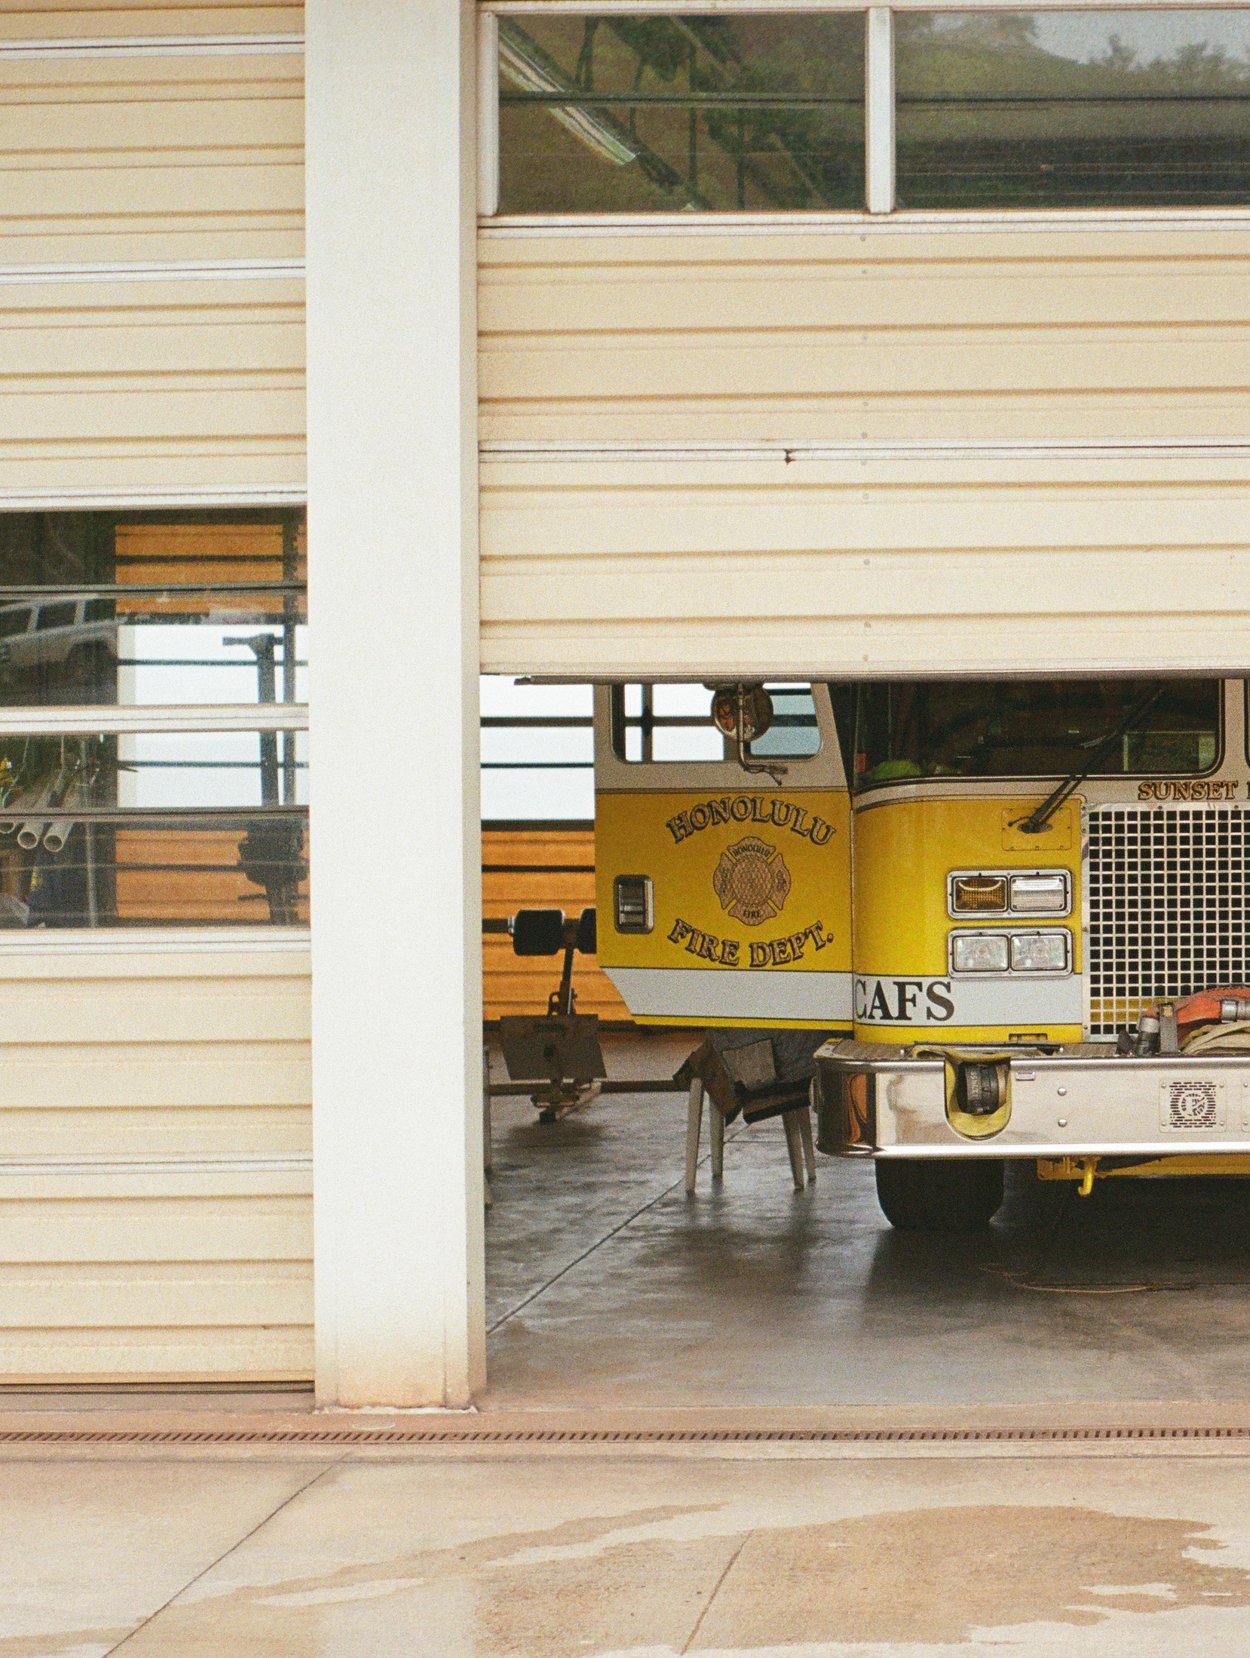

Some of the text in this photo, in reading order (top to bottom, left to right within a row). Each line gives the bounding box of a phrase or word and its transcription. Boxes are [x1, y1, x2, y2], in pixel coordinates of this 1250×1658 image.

[1138, 780, 1238, 800] SUNSET
[665, 796, 837, 846] HONOLULU
[743, 909, 761, 918] FIRE
[667, 918, 835, 968] FIRE DEPT.
[854, 980, 955, 1022] CAFS
